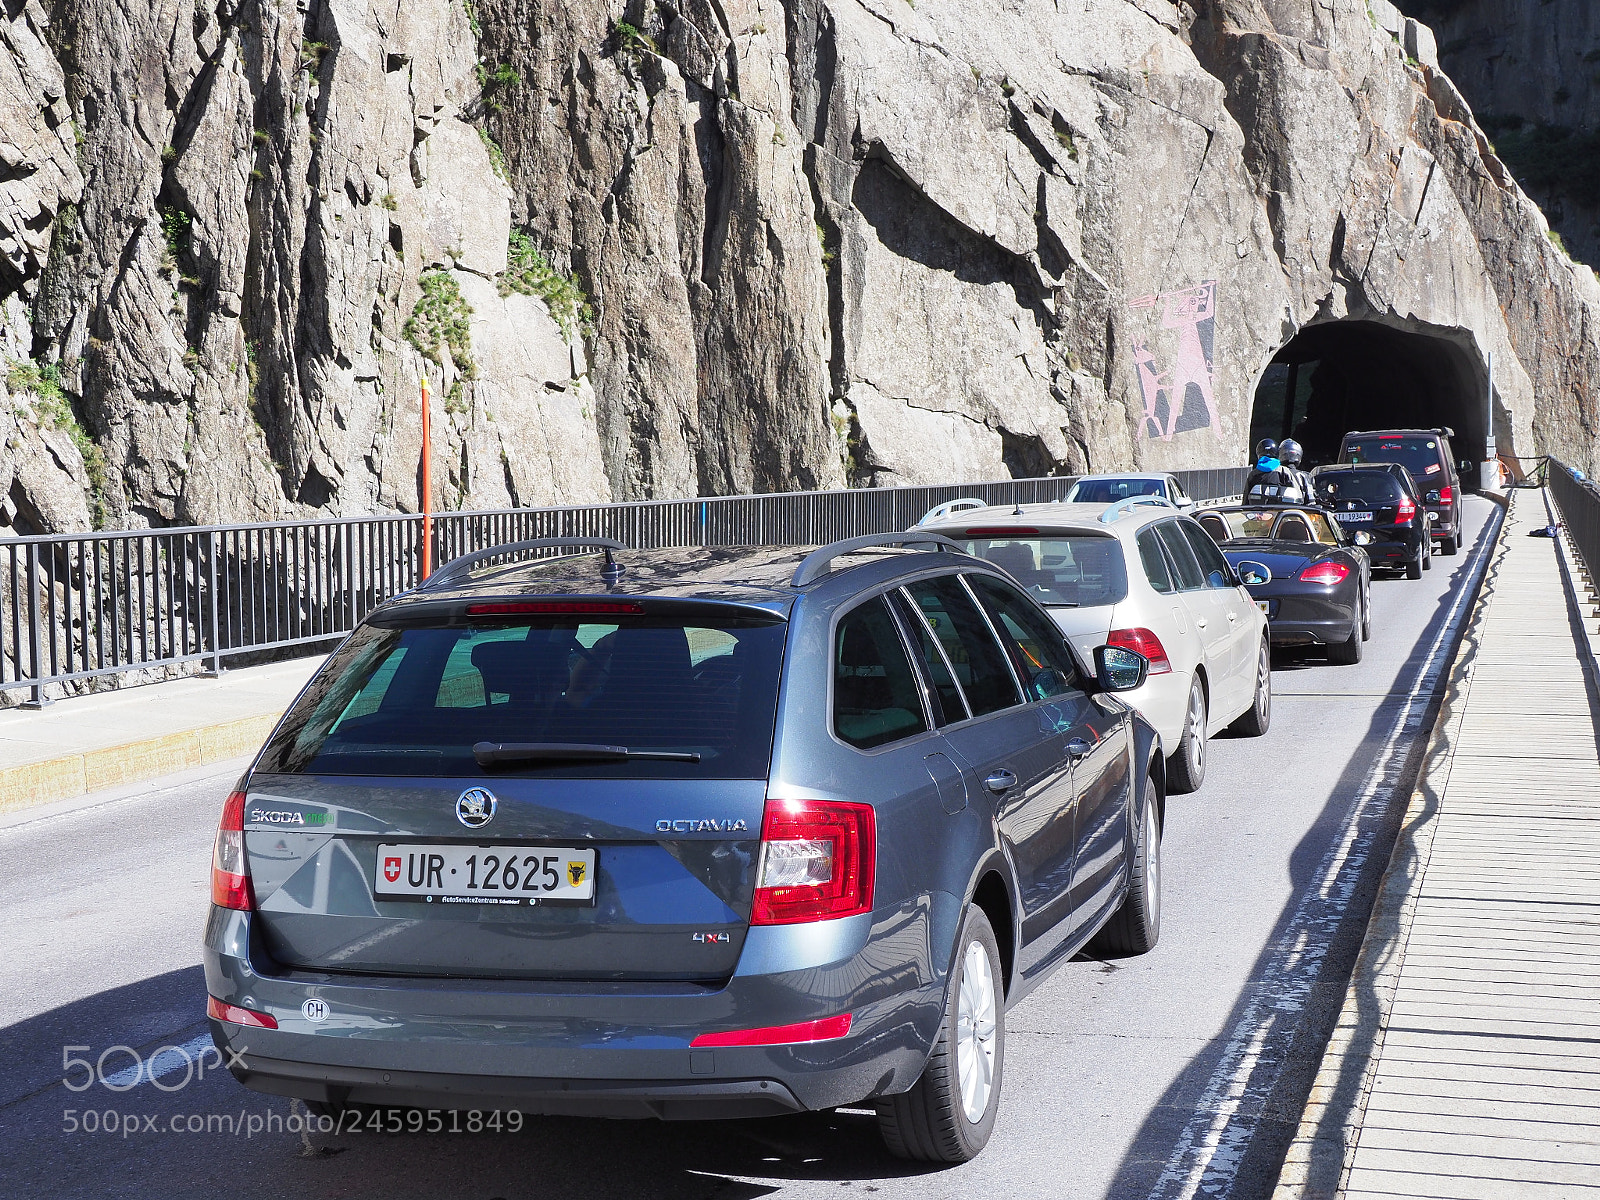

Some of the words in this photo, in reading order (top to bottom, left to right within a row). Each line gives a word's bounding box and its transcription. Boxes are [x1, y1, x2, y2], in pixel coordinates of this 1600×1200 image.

[250, 807, 304, 824] ŠKODA
[655, 818, 748, 832] OCTAVIA
[308, 1002, 323, 1018] CH
